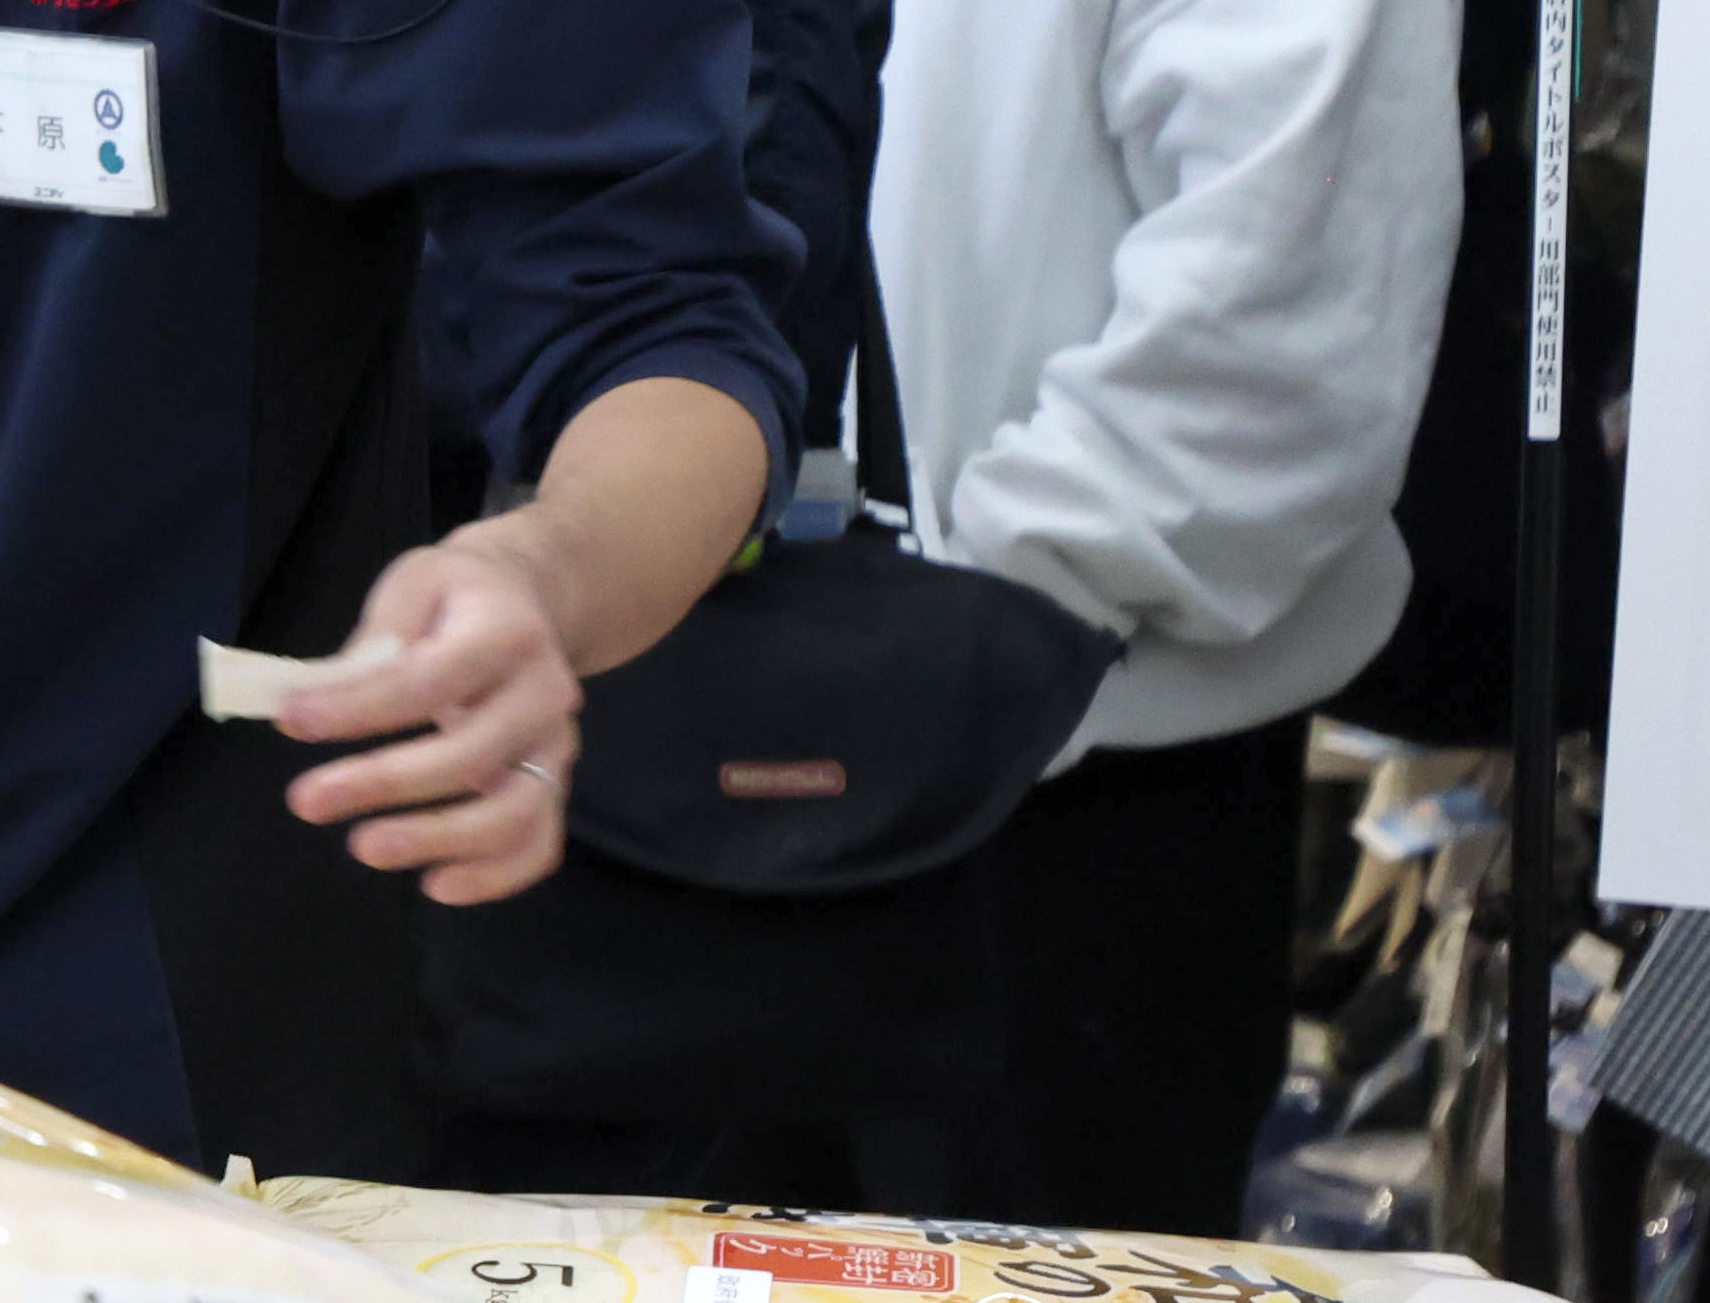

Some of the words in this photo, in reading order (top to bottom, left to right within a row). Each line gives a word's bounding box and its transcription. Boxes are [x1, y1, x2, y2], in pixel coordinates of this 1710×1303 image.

[730, 1238, 929, 1271] 新鮮パック
